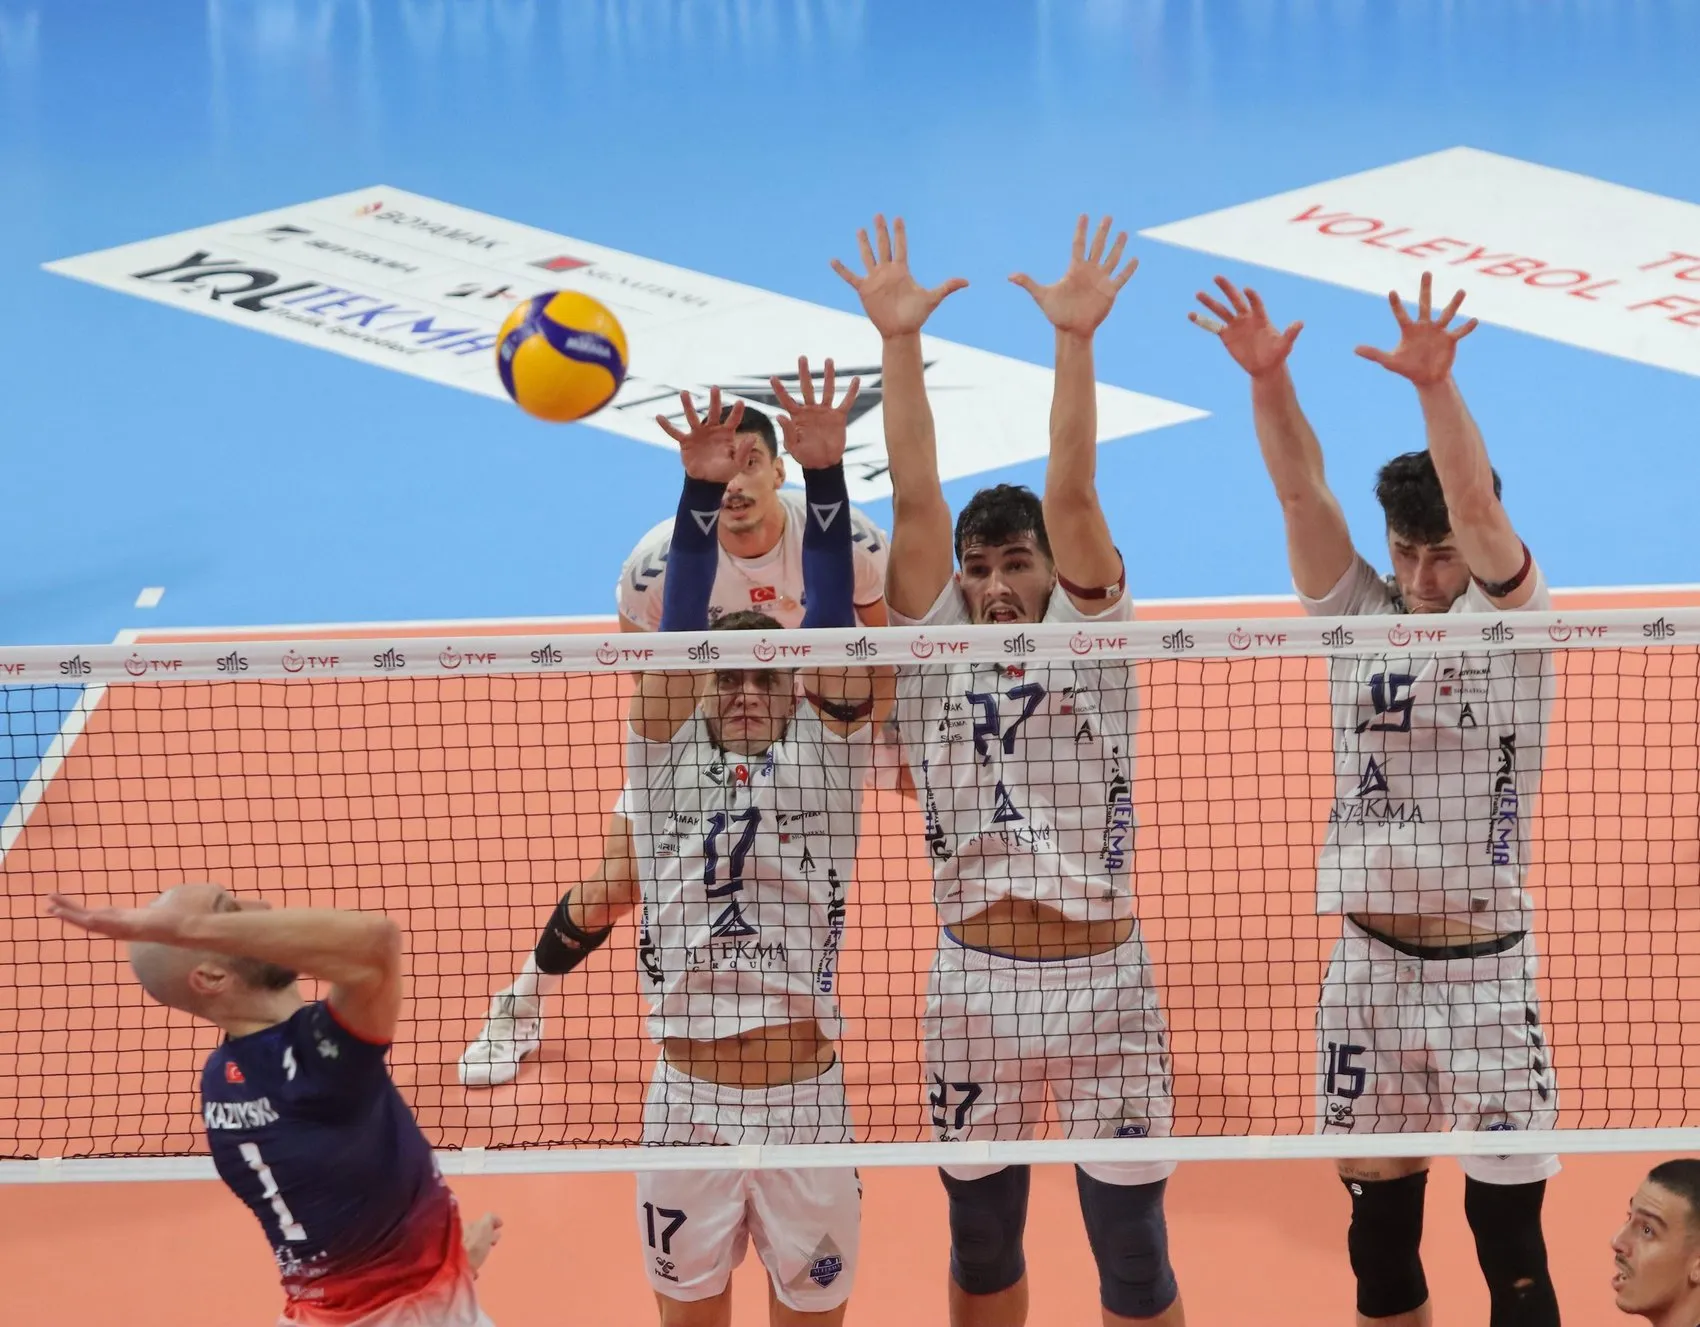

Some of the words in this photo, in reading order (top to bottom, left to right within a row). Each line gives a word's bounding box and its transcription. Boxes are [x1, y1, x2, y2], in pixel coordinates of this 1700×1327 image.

[1287, 204, 1620, 301] VOLEYBOL
[150, 659, 183, 671] TVF
[308, 656, 340, 668] TVF
[464, 653, 497, 665] TVF
[622, 649, 654, 661] TVF
[779, 645, 812, 657] TVF
[937, 641, 970, 654] TVF
[1095, 638, 1128, 650] TVF
[1255, 634, 1288, 646] TVF
[1414, 629, 1447, 642] TVF
[1574, 626, 1608, 638] TVF
[703, 806, 763, 898] 17
[1326, 1041, 1367, 1100] 15
[237, 1142, 308, 1241] 1
[642, 1201, 688, 1255] 17
